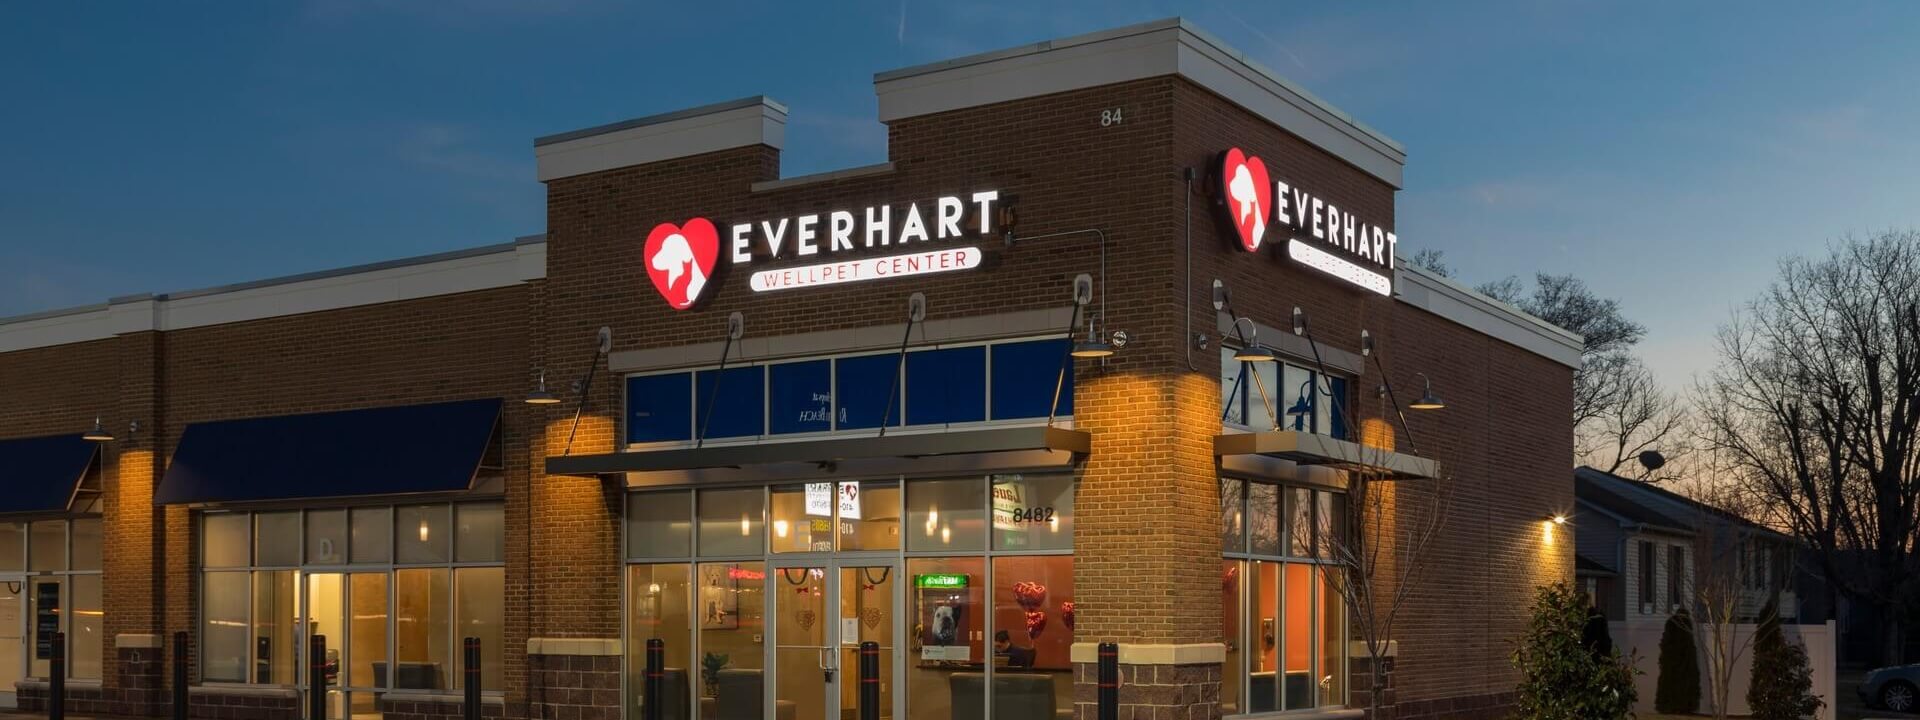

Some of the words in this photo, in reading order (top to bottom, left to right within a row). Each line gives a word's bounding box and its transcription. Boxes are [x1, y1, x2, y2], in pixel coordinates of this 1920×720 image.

[1101, 108, 1122, 127] 84
[732, 190, 998, 263] EVERHART
[1278, 181, 1397, 269] EVERHART
[763, 264, 860, 288] WELLPET
[876, 251, 967, 275] CENTER
[1013, 507, 1054, 523] 8482
[320, 538, 332, 560] D
